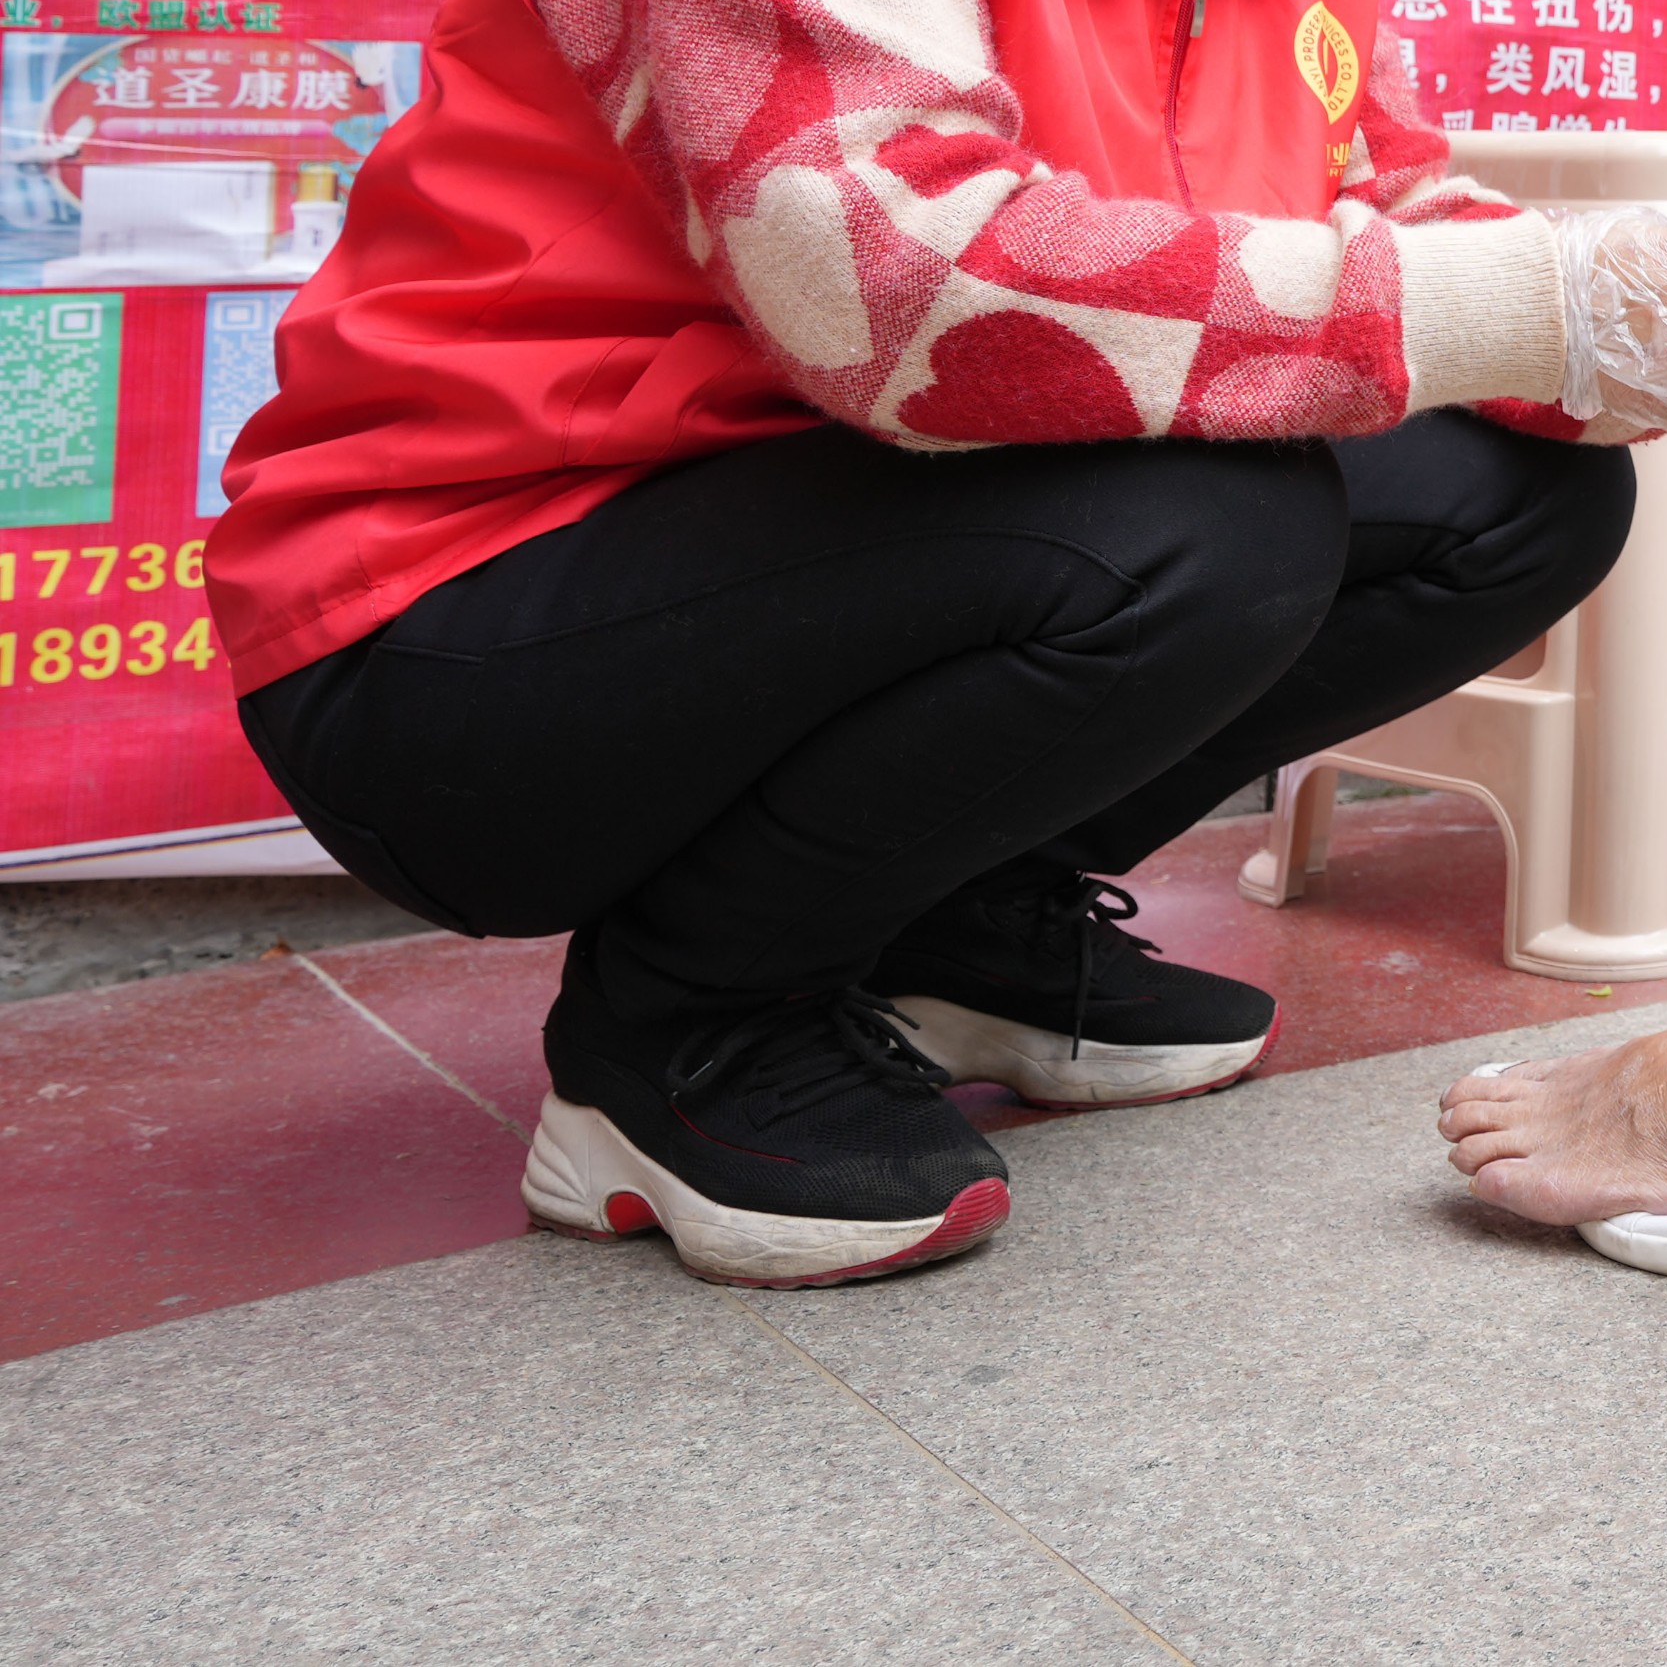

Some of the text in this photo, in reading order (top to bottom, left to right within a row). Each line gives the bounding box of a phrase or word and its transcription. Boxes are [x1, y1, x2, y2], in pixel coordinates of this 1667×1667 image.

[1303, 9, 1321, 62] PROPER
[93, 66, 353, 112] 道圣康膜
[1309, 66, 1327, 99] NYI
[0, 617, 231, 687] 18934
